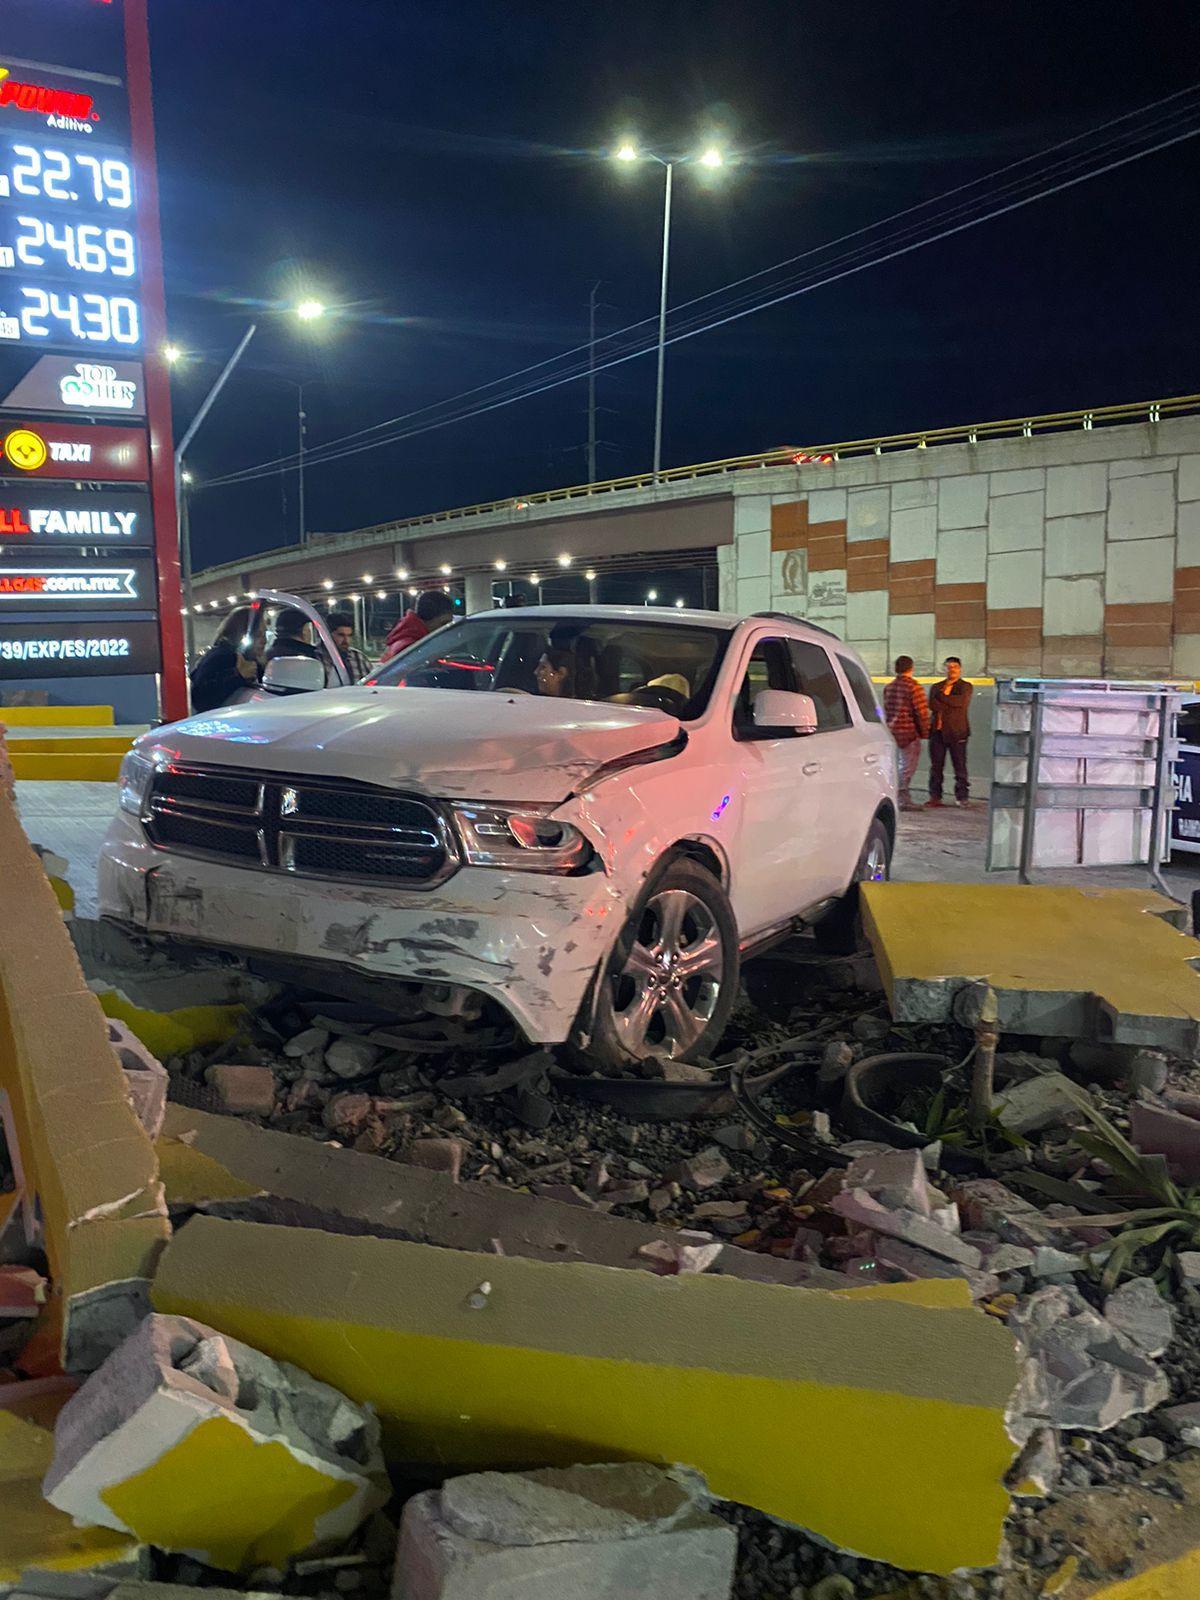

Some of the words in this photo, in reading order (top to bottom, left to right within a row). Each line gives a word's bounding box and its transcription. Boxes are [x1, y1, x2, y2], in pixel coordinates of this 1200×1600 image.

[46, 114, 93, 134] Aditivo
[12, 144, 133, 208] 22.79
[16, 216, 135, 278] 24.69
[20, 286, 139, 345] 24.30
[77, 364, 116, 382] TOP
[48, 442, 91, 462] TAXI
[0, 638, 129, 660] 39/EXP/ES/2022
